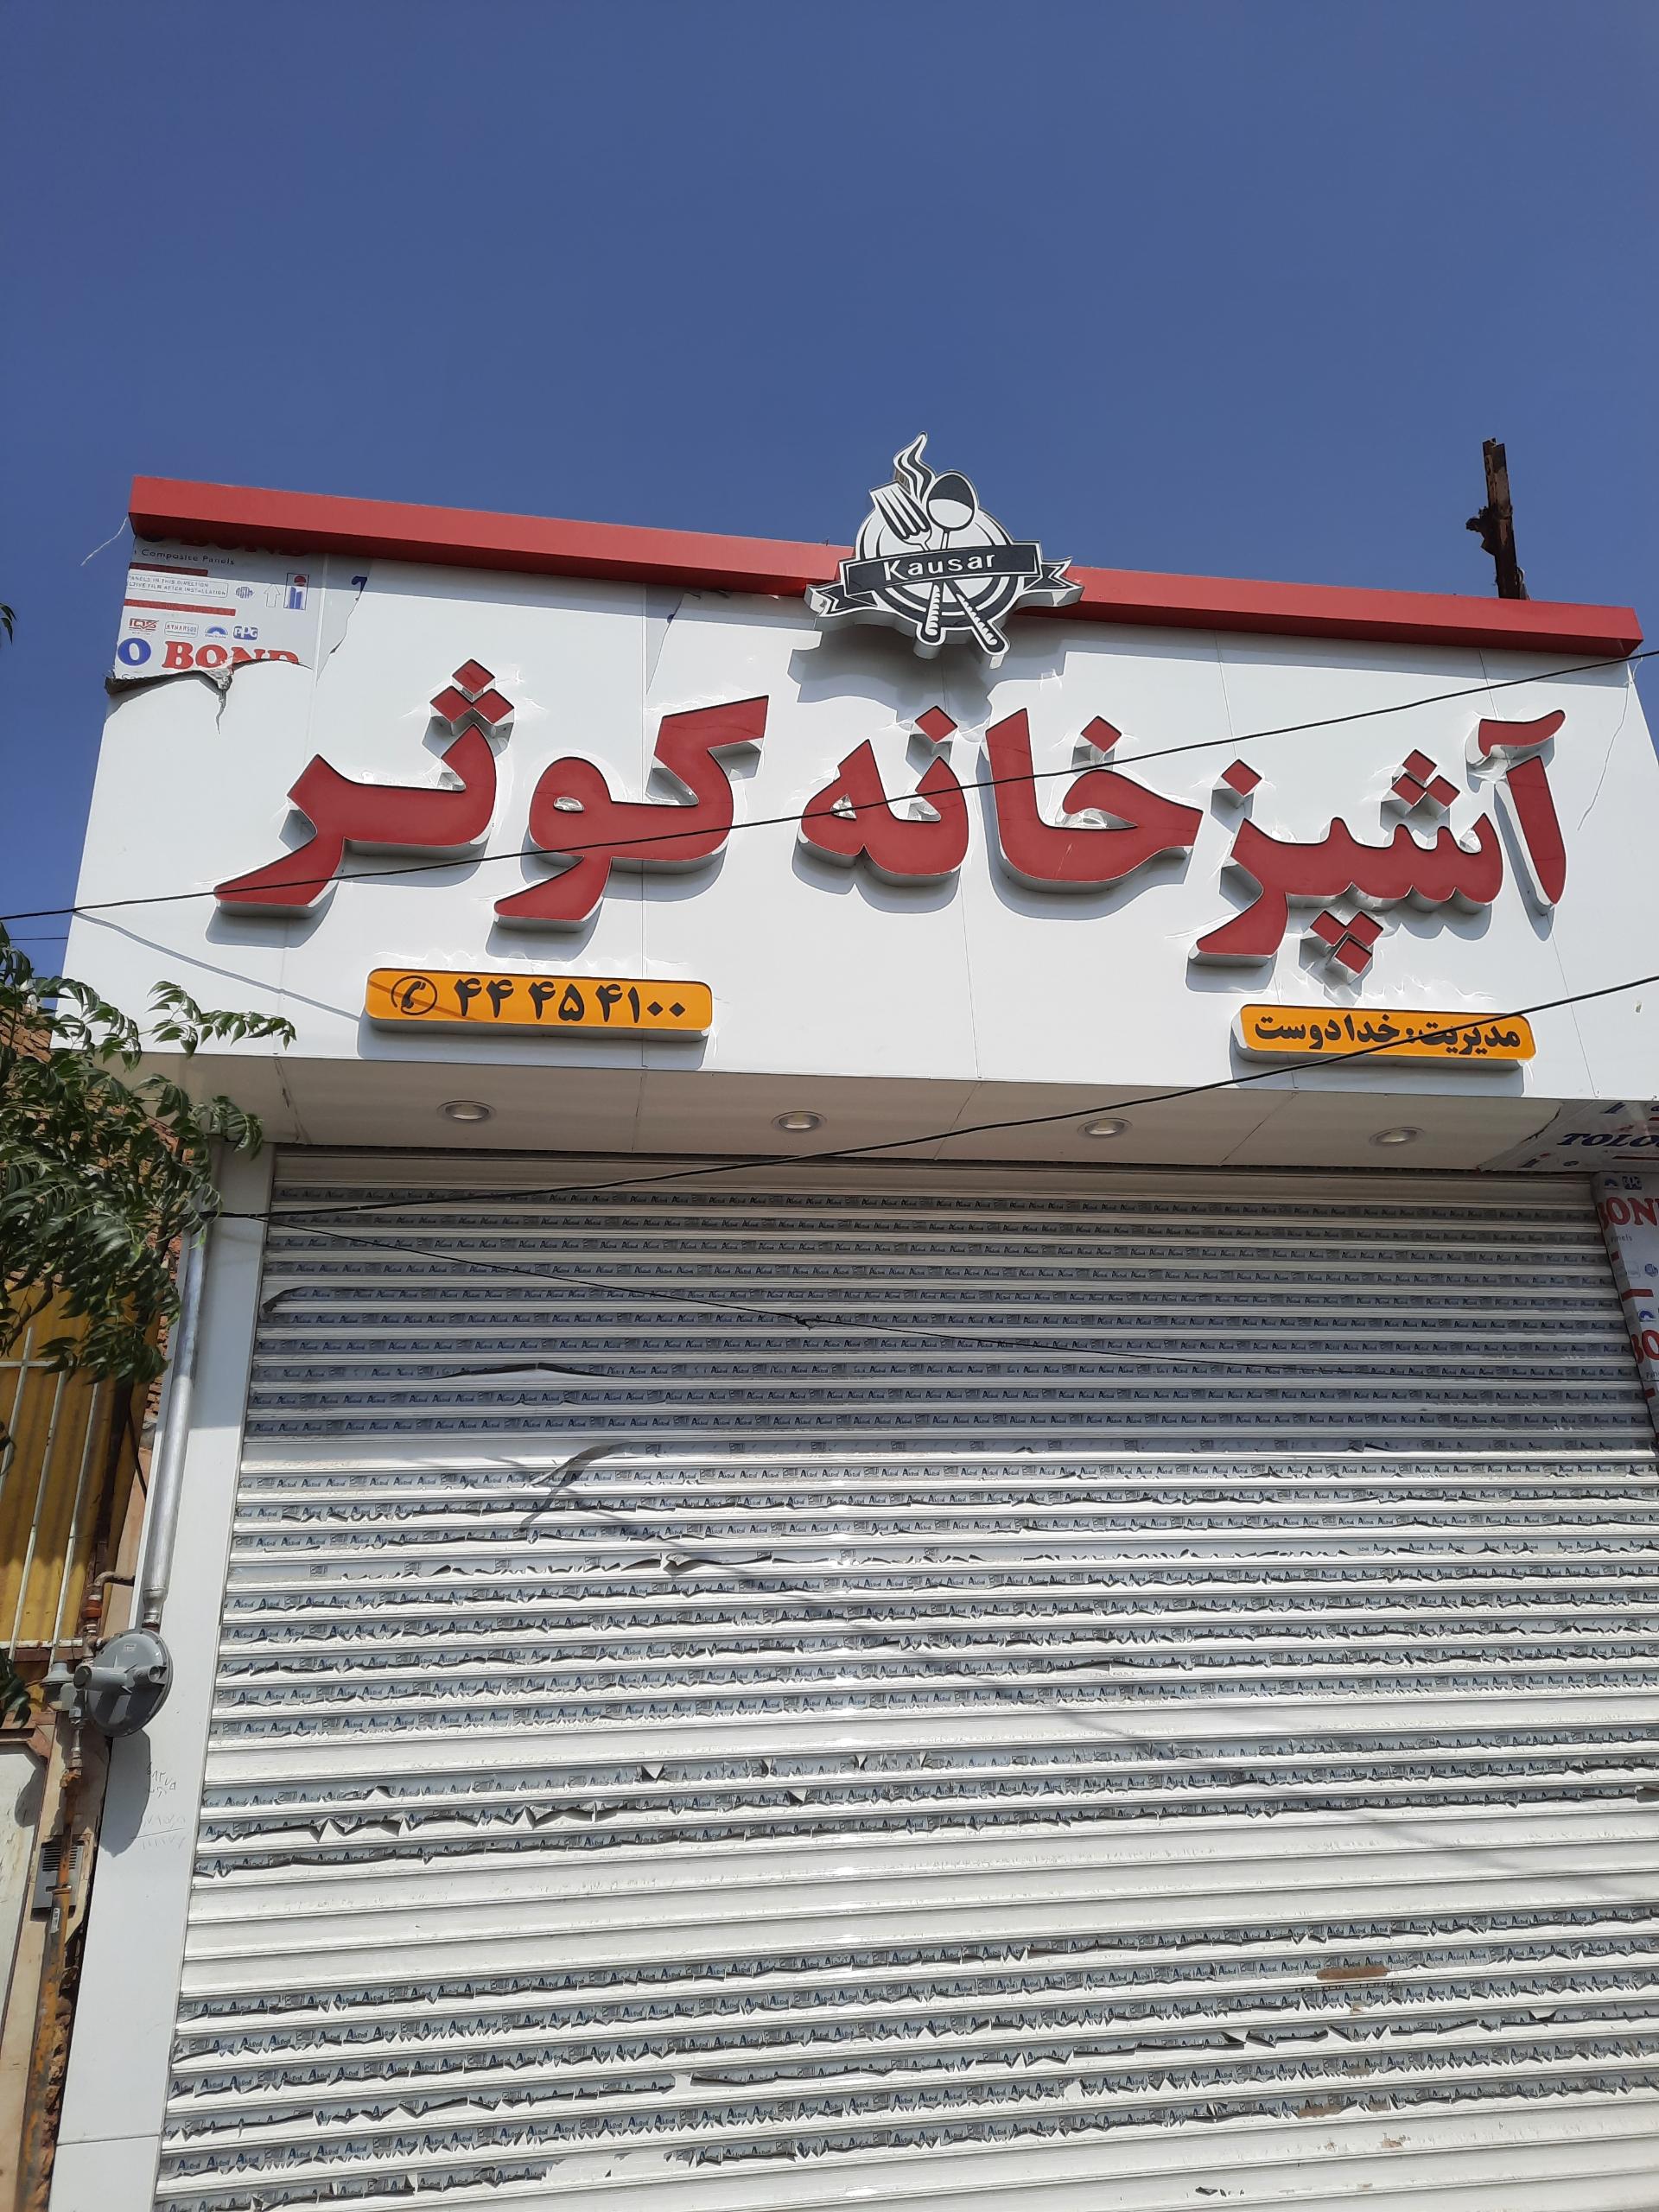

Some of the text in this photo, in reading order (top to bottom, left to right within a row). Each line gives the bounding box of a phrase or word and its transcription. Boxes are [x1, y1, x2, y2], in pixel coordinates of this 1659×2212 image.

[882, 553, 995, 582] Kausar
[213, 658, 1567, 976] آشپزخانه کوثر
